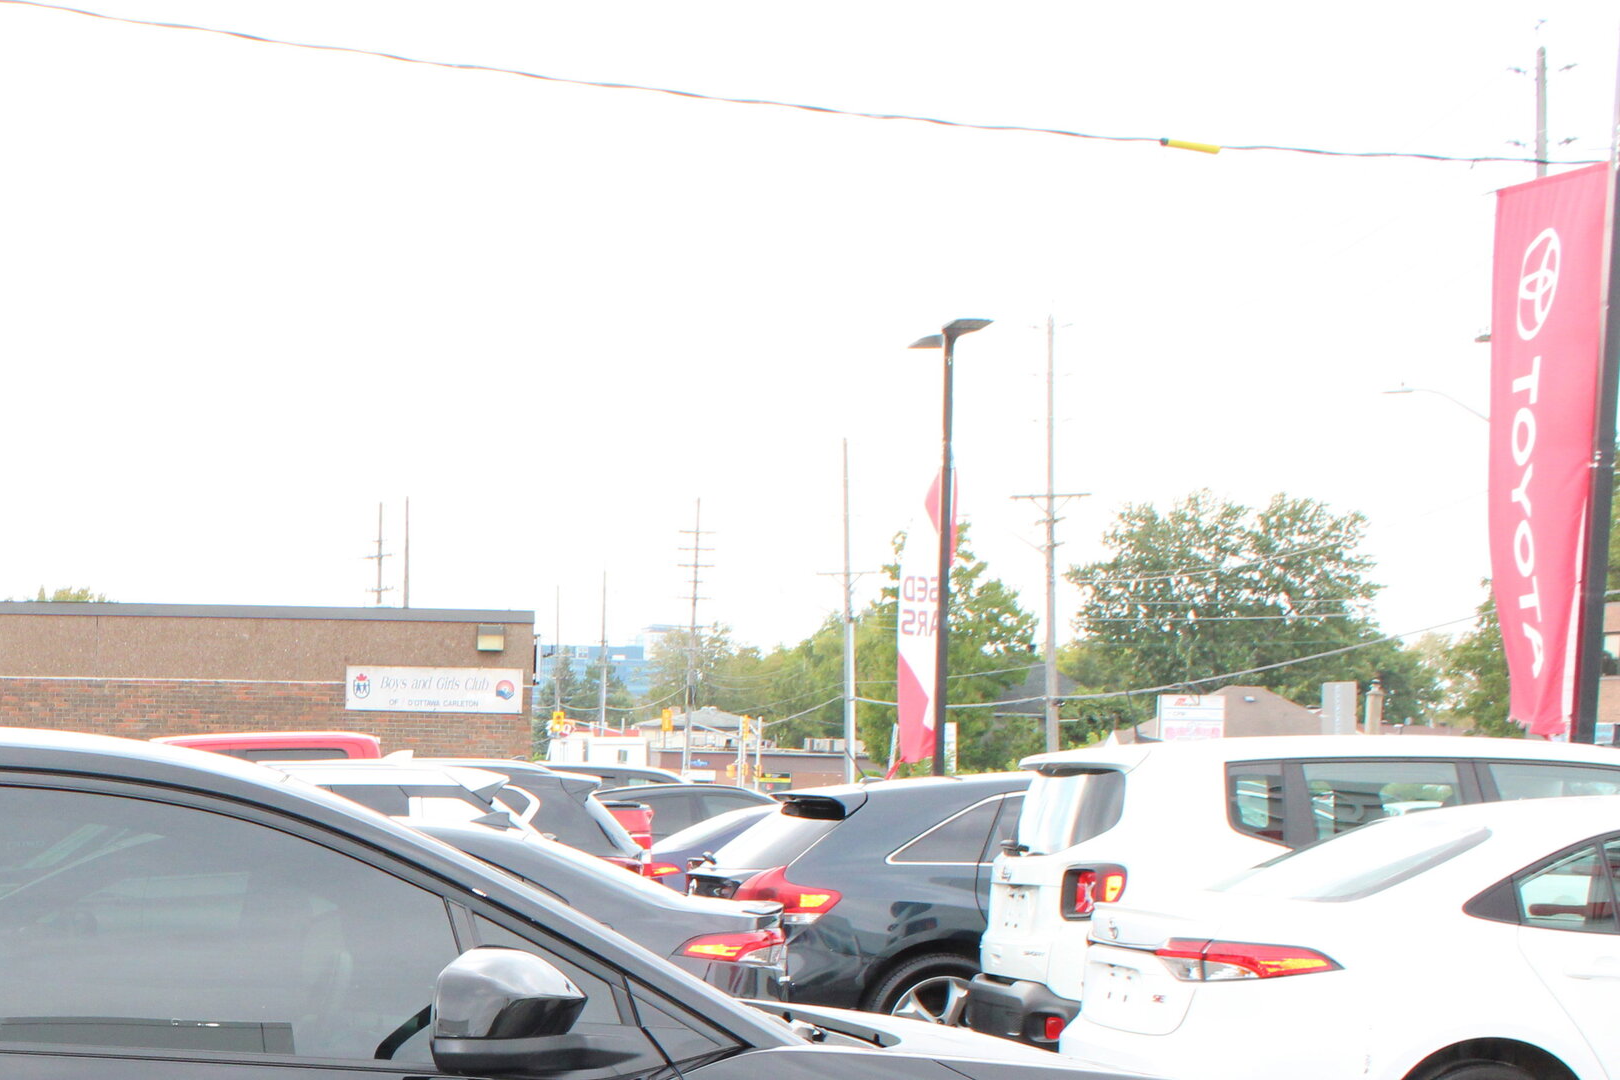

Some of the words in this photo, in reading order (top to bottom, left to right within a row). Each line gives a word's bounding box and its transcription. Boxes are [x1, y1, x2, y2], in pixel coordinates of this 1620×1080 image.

[1510, 354, 1545, 680] TOYOTA
[380, 676, 407, 692] Boys
[411, 677, 432, 690] and
[436, 677, 460, 691] Girls
[464, 677, 489, 691] Club
[443, 700, 479, 708] CARLETON
